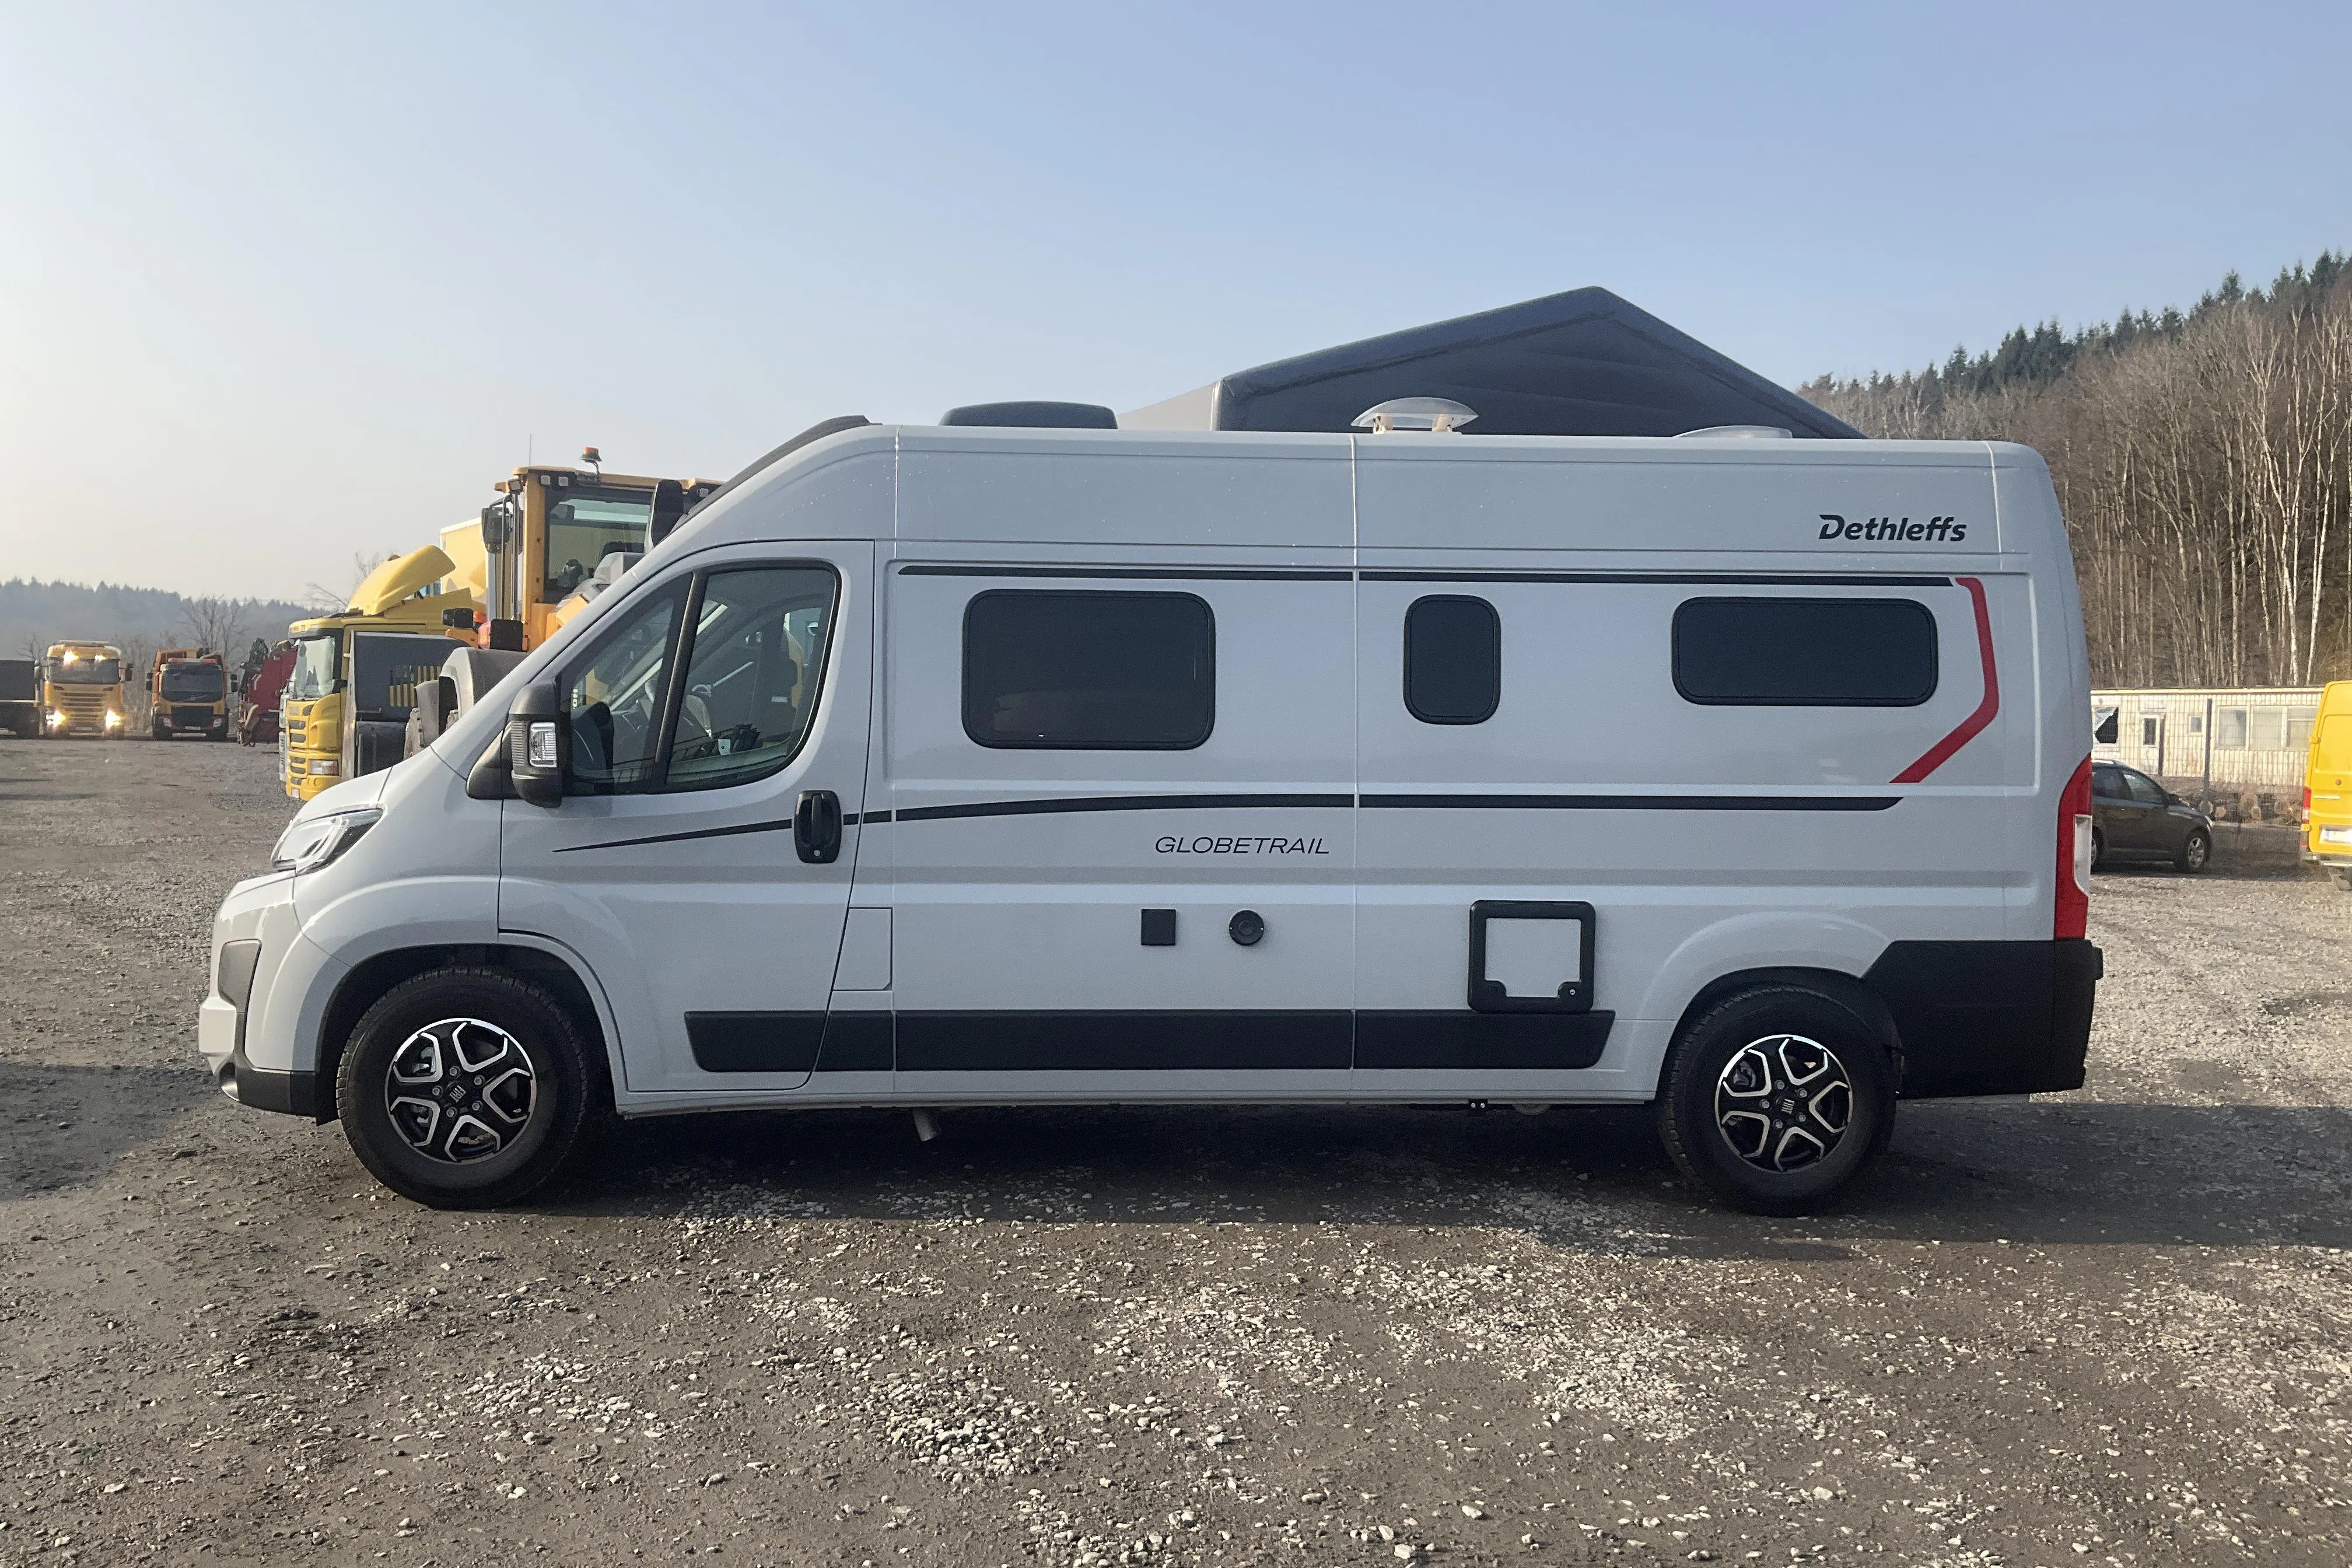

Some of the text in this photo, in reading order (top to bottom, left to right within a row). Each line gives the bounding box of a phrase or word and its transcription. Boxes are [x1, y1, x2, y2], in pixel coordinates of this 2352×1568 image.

[1818, 514, 1967, 542] Dethleffs
[1154, 836, 1330, 855] GLOBETRAIL
[449, 1084, 467, 1103] FIAT
